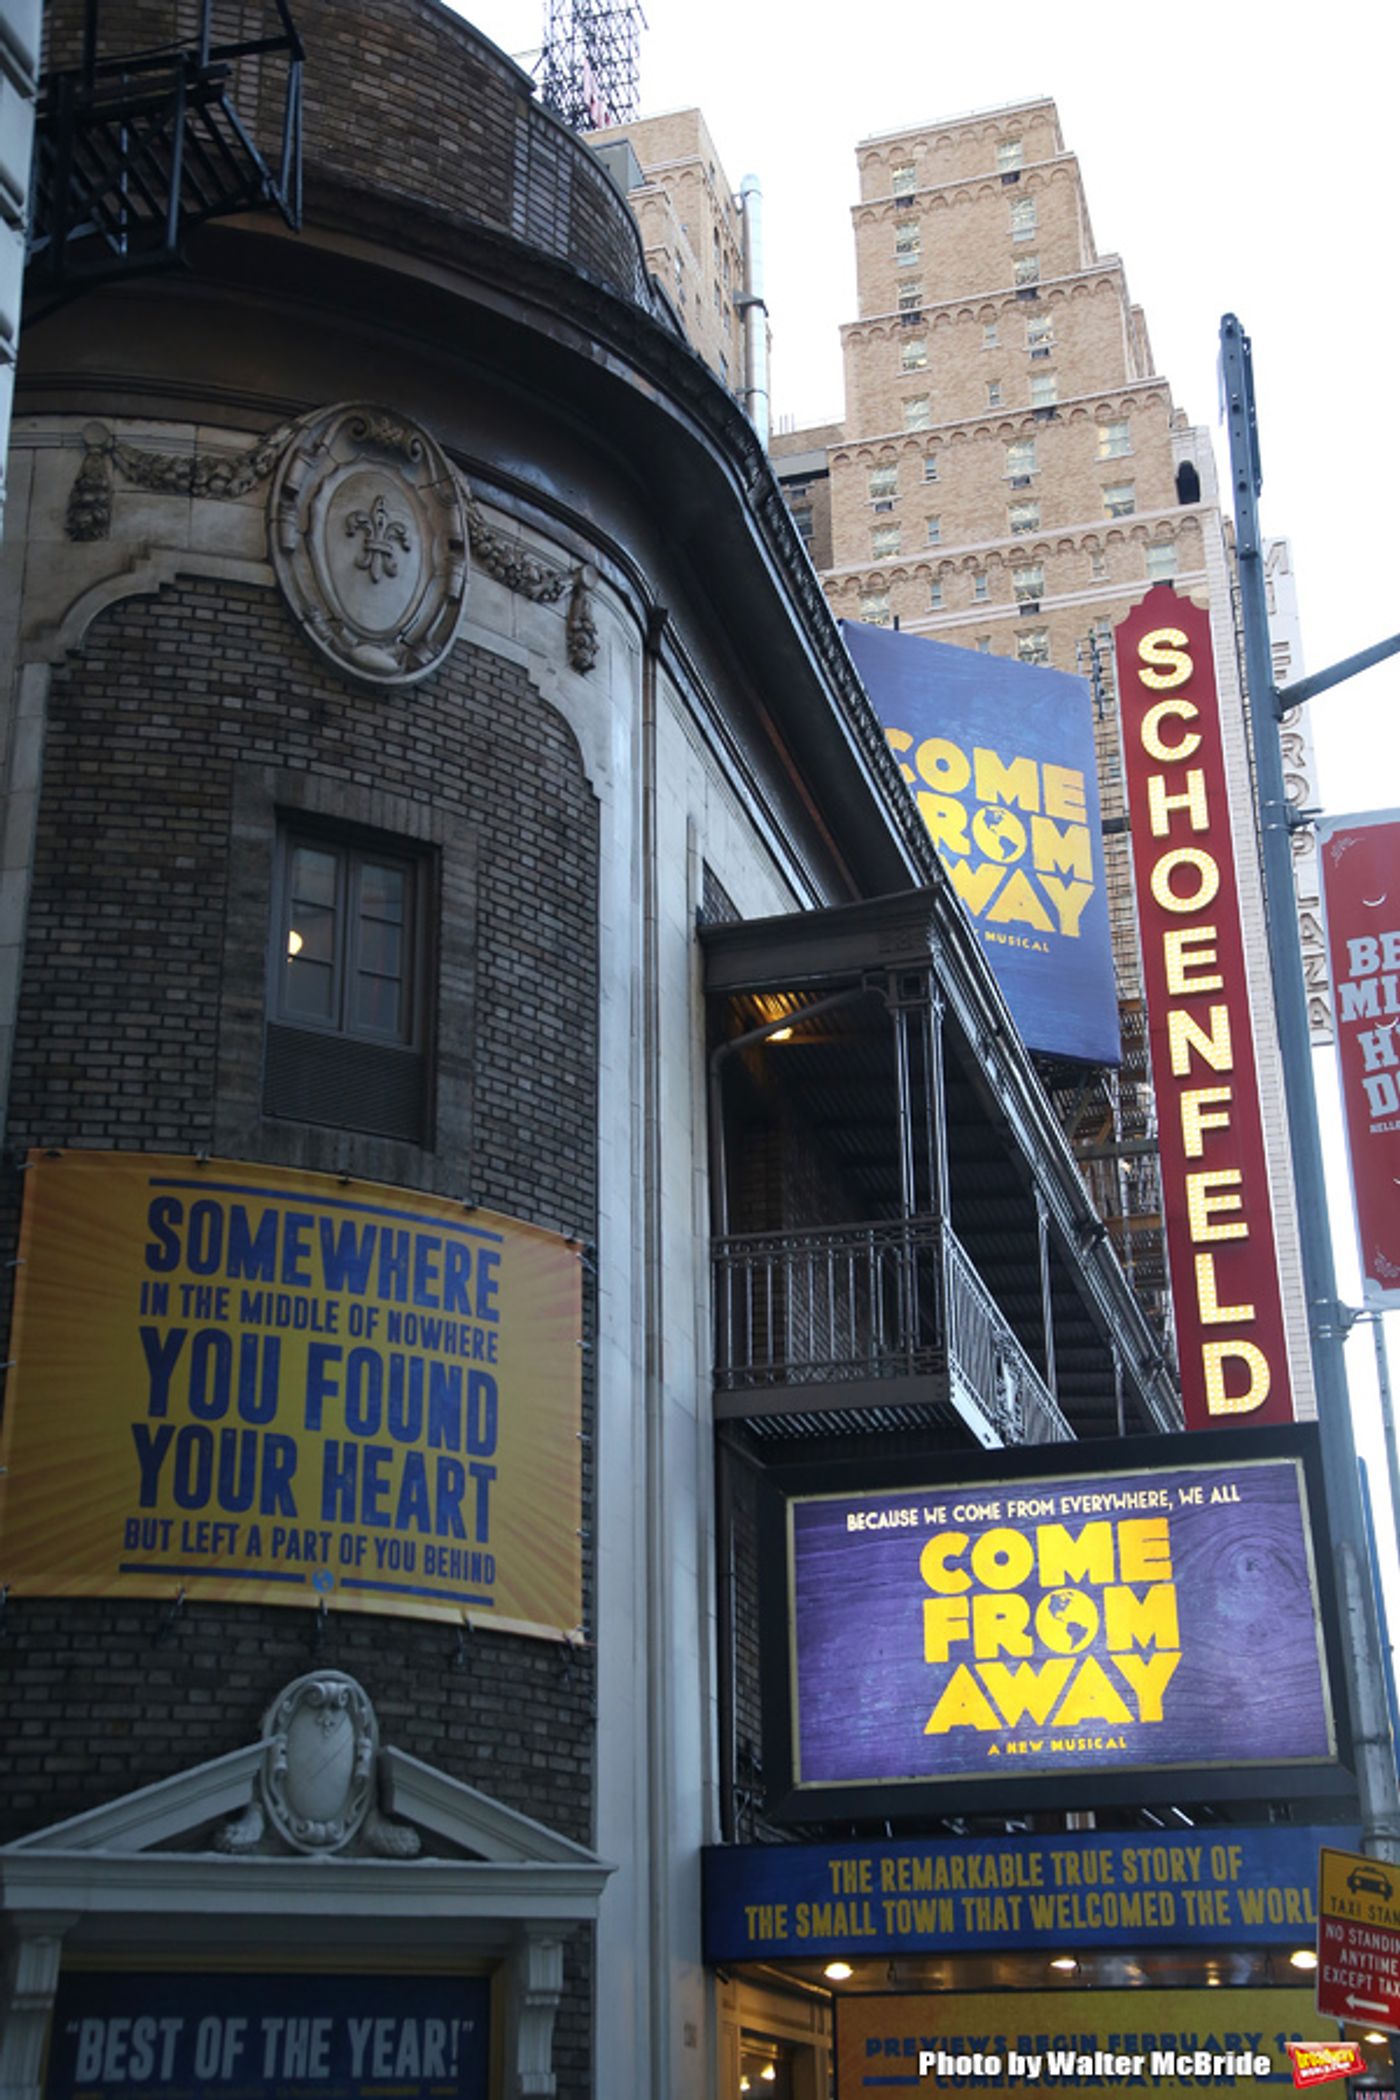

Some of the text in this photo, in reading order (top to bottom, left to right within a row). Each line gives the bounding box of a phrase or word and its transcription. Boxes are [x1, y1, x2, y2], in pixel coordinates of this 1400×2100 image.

[985, 931, 1050, 953] MUSICAL
[1137, 627, 1271, 1416] SCHOENFELD
[145, 1195, 501, 1323] SOMEWHERE
[139, 1281, 499, 1364] IN THE MIDDLE OF NOWHERE
[138, 1325, 498, 1458] YOU FOUND
[131, 1422, 498, 1544] YOUR HEART
[846, 1484, 1241, 1532] BECAUSE WE COME FROM EVERYWHERE, WE ALL
[123, 1517, 496, 1585] BUT LEFT A PART OF YOU BEHIND
[919, 1517, 1174, 1595] COME
[922, 1583, 1180, 1664] FROM
[924, 1651, 1183, 1735] AWAY
[987, 1736, 1128, 1756] A NEW MUSICAL
[828, 1845, 1243, 1895] THE REMARKABLE TRUE STORY OF
[745, 1905, 789, 1940] THE
[795, 1900, 877, 1938] SMALL
[882, 1898, 954, 1935] TOWN
[962, 1896, 1026, 1932] THAT
[1030, 1890, 1176, 1930] WELCOMED
[1182, 1888, 1230, 1927] THE
[1325, 1924, 1344, 1941] NO
[1331, 1897, 1362, 1916] TAXI
[1323, 1967, 1373, 1992] EXCEPT
[1339, 1949, 1399, 1976] ANYTIME
[197, 2016, 249, 2079] OF
[260, 2017, 334, 2078] THE
[866, 2035, 1007, 2057] PREVIEWS
[1017, 2033, 1097, 2054] BEGIN
[1108, 2032, 1263, 2052] FEBRUARY
